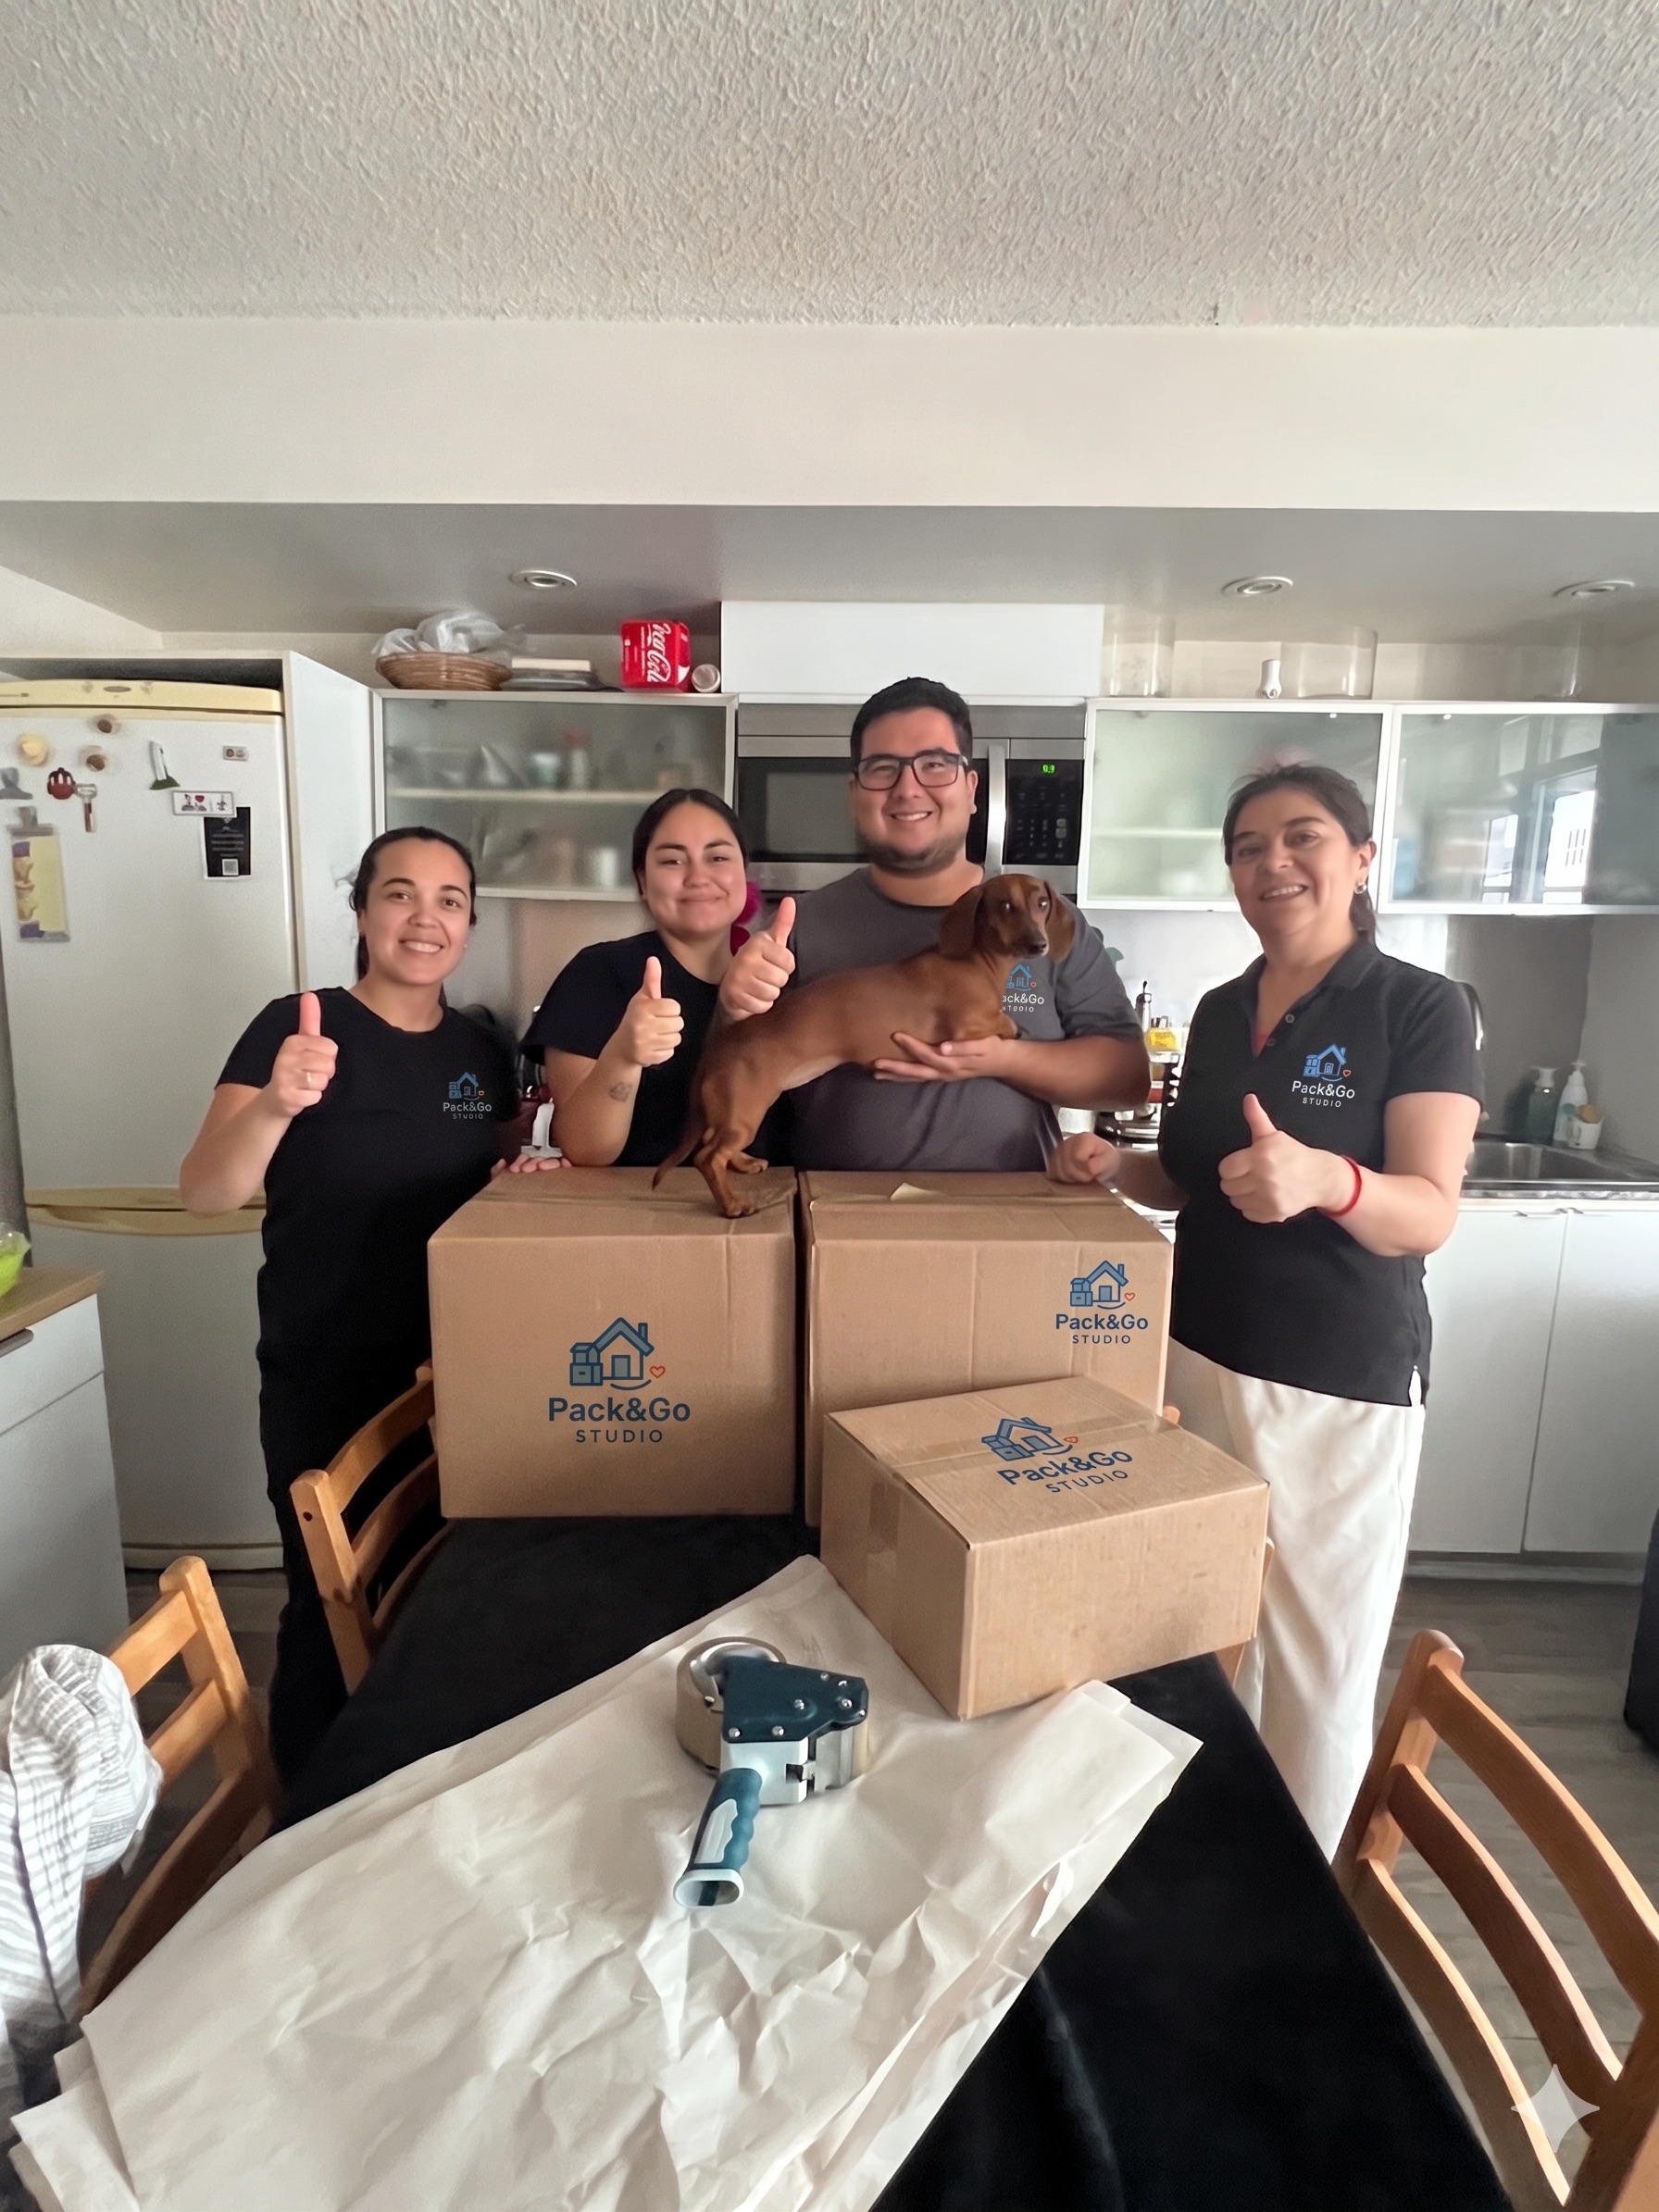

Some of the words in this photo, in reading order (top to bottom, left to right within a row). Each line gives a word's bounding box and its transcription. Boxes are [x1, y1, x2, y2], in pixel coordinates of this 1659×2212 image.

[1002, 993, 1045, 1005] ack&Go
[1291, 1080, 1355, 1099] Pack&Go
[443, 1101, 493, 1112] Pack&Go
[1302, 1097, 1341, 1108] STUDIO
[1055, 1313, 1149, 1330] Pack&Go
[1072, 1335, 1131, 1344] STUDIO
[548, 1397, 691, 1422] Pack&Go
[576, 1429, 663, 1443] STUDIO
[996, 1451, 1133, 1485] Pack&Go
[1045, 1470, 1129, 1493] STUDIO
